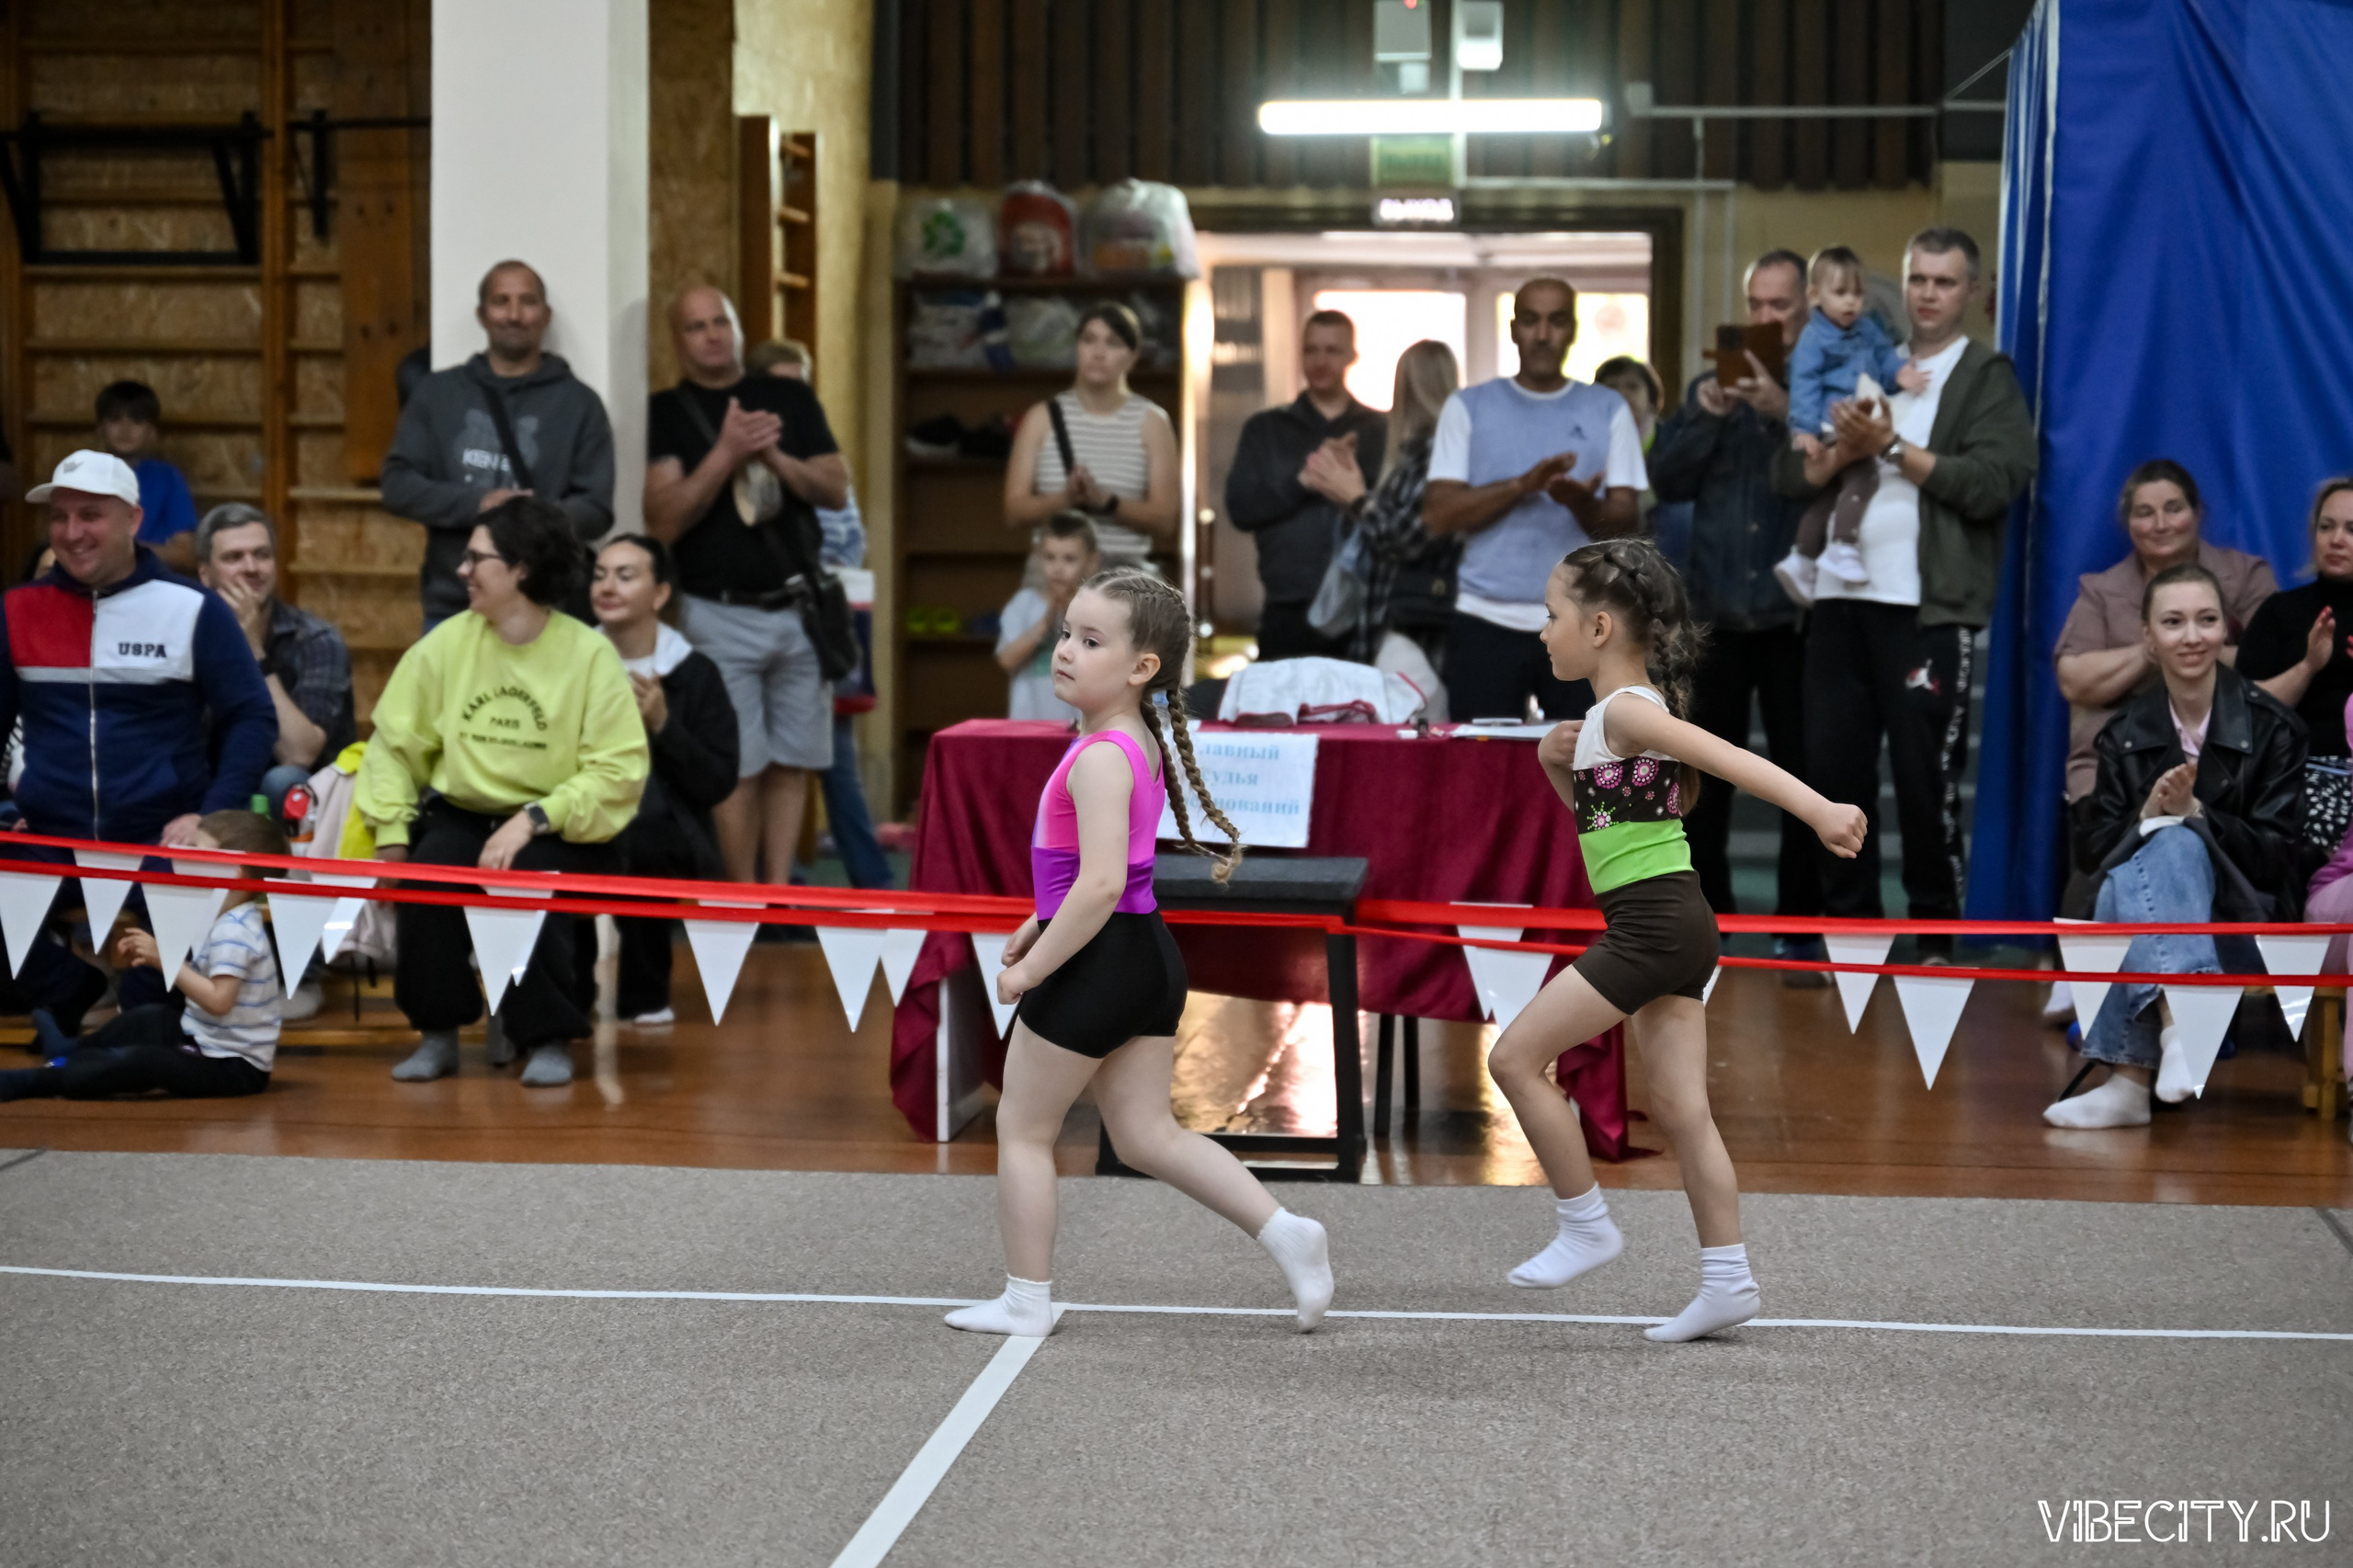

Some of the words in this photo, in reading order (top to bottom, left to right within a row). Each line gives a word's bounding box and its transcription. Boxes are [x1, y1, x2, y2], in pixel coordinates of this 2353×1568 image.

[118, 642, 167, 658] USPA
[461, 692, 492, 722] KARL
[1199, 743, 1279, 761] лавный
